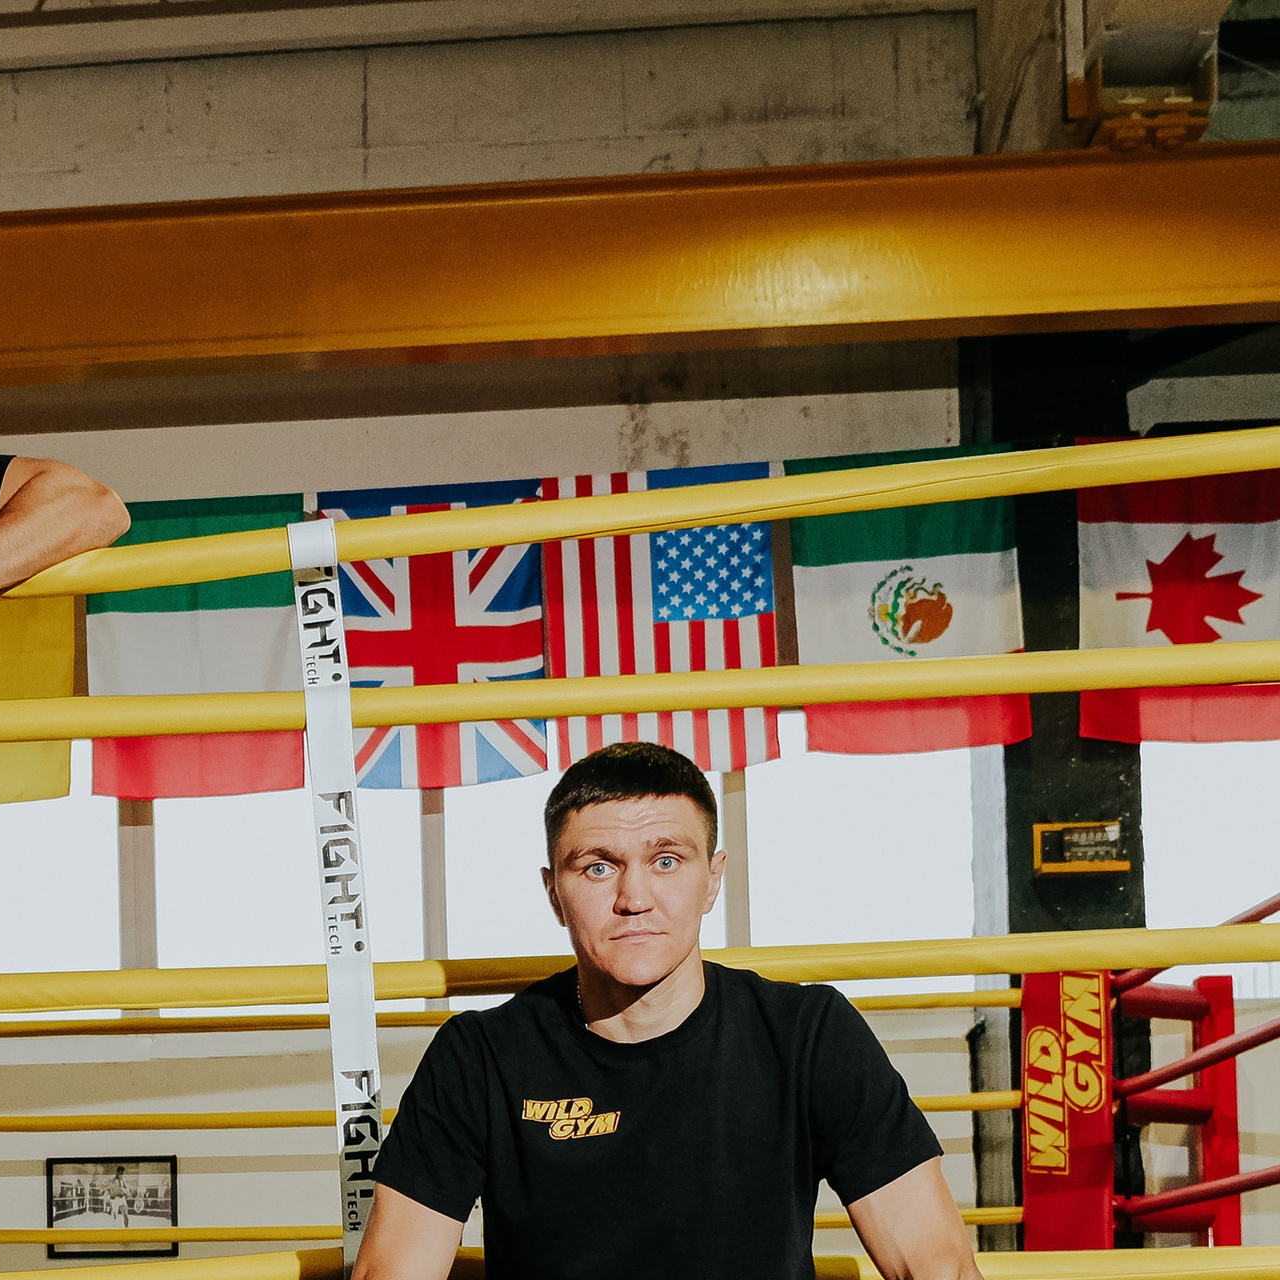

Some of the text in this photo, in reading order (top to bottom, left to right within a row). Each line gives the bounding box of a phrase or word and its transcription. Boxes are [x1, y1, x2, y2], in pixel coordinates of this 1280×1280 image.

[306, 655, 320, 684] TECH
[317, 791, 364, 929] FIGHT
[328, 914, 342, 954] TECH
[1063, 976, 1101, 1107] GYM
[525, 1100, 590, 1120] WILD
[1028, 1029, 1065, 1168] WILD
[551, 1112, 616, 1138] GYM
[346, 1190, 361, 1231] TECH
